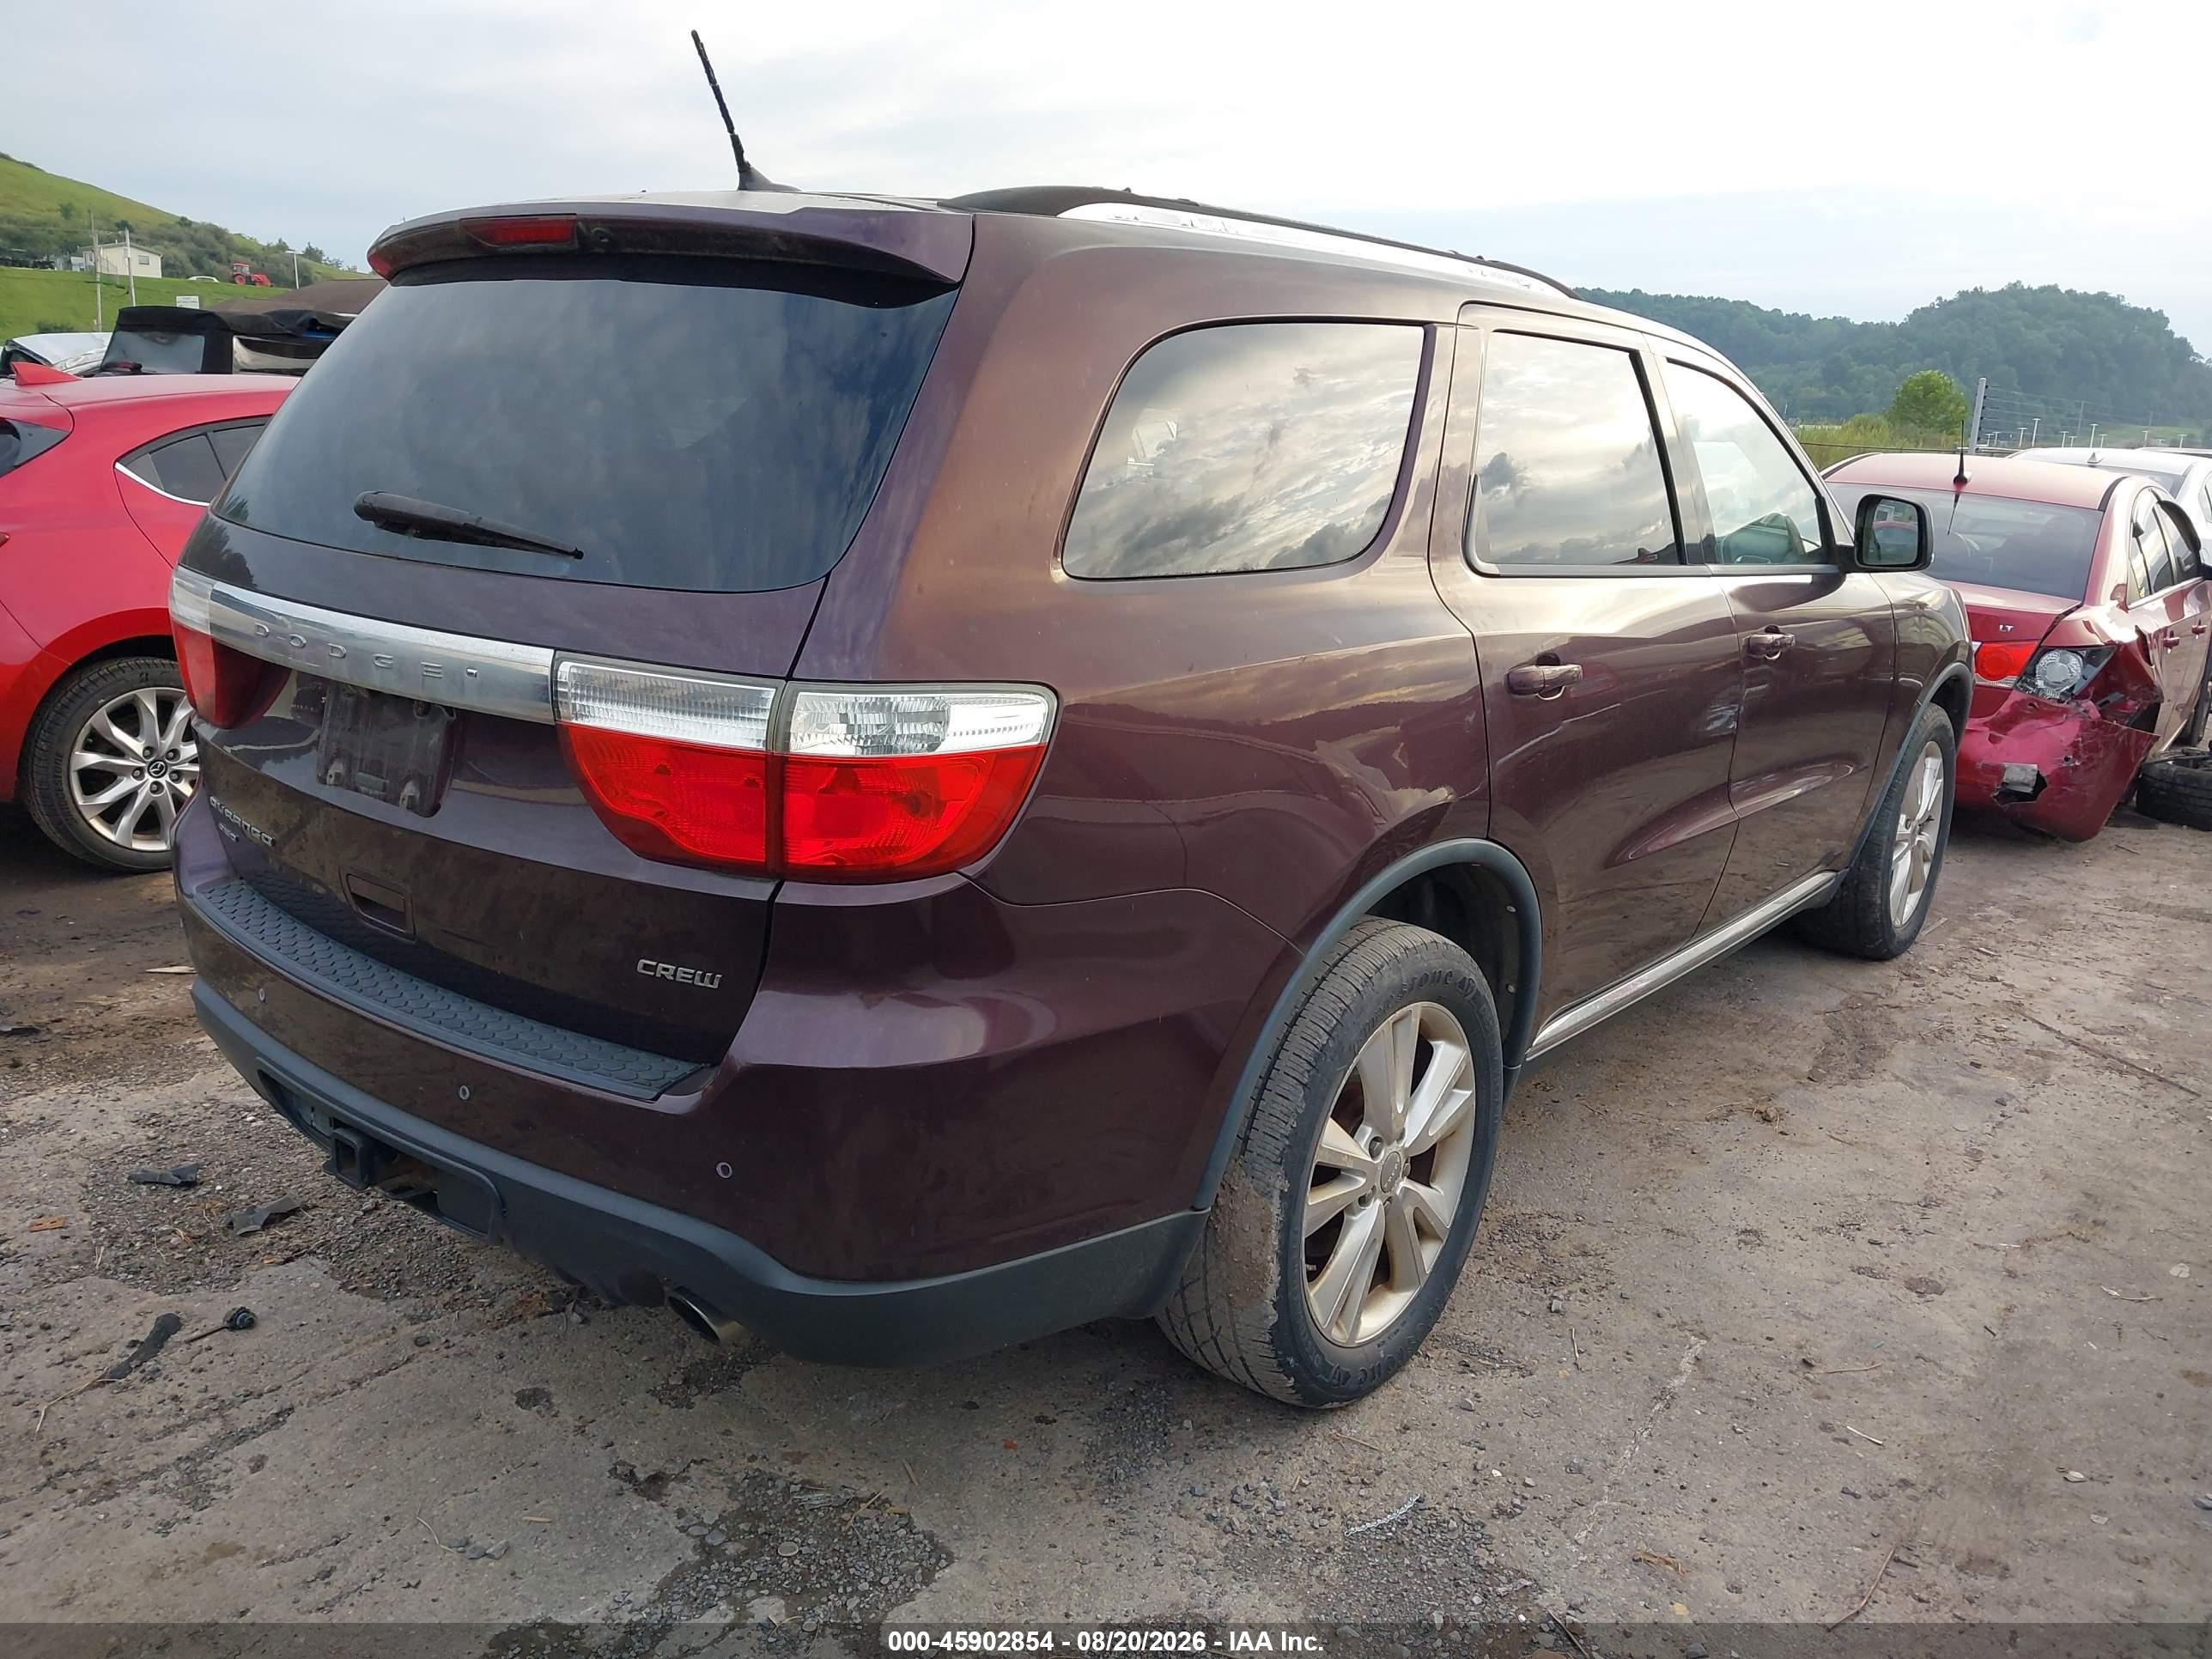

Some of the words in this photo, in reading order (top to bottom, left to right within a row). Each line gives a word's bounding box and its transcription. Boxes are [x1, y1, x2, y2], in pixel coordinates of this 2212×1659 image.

[254, 622, 444, 679] DODGE
[209, 795, 274, 847] DURANGO
[637, 958, 722, 988] CREW
